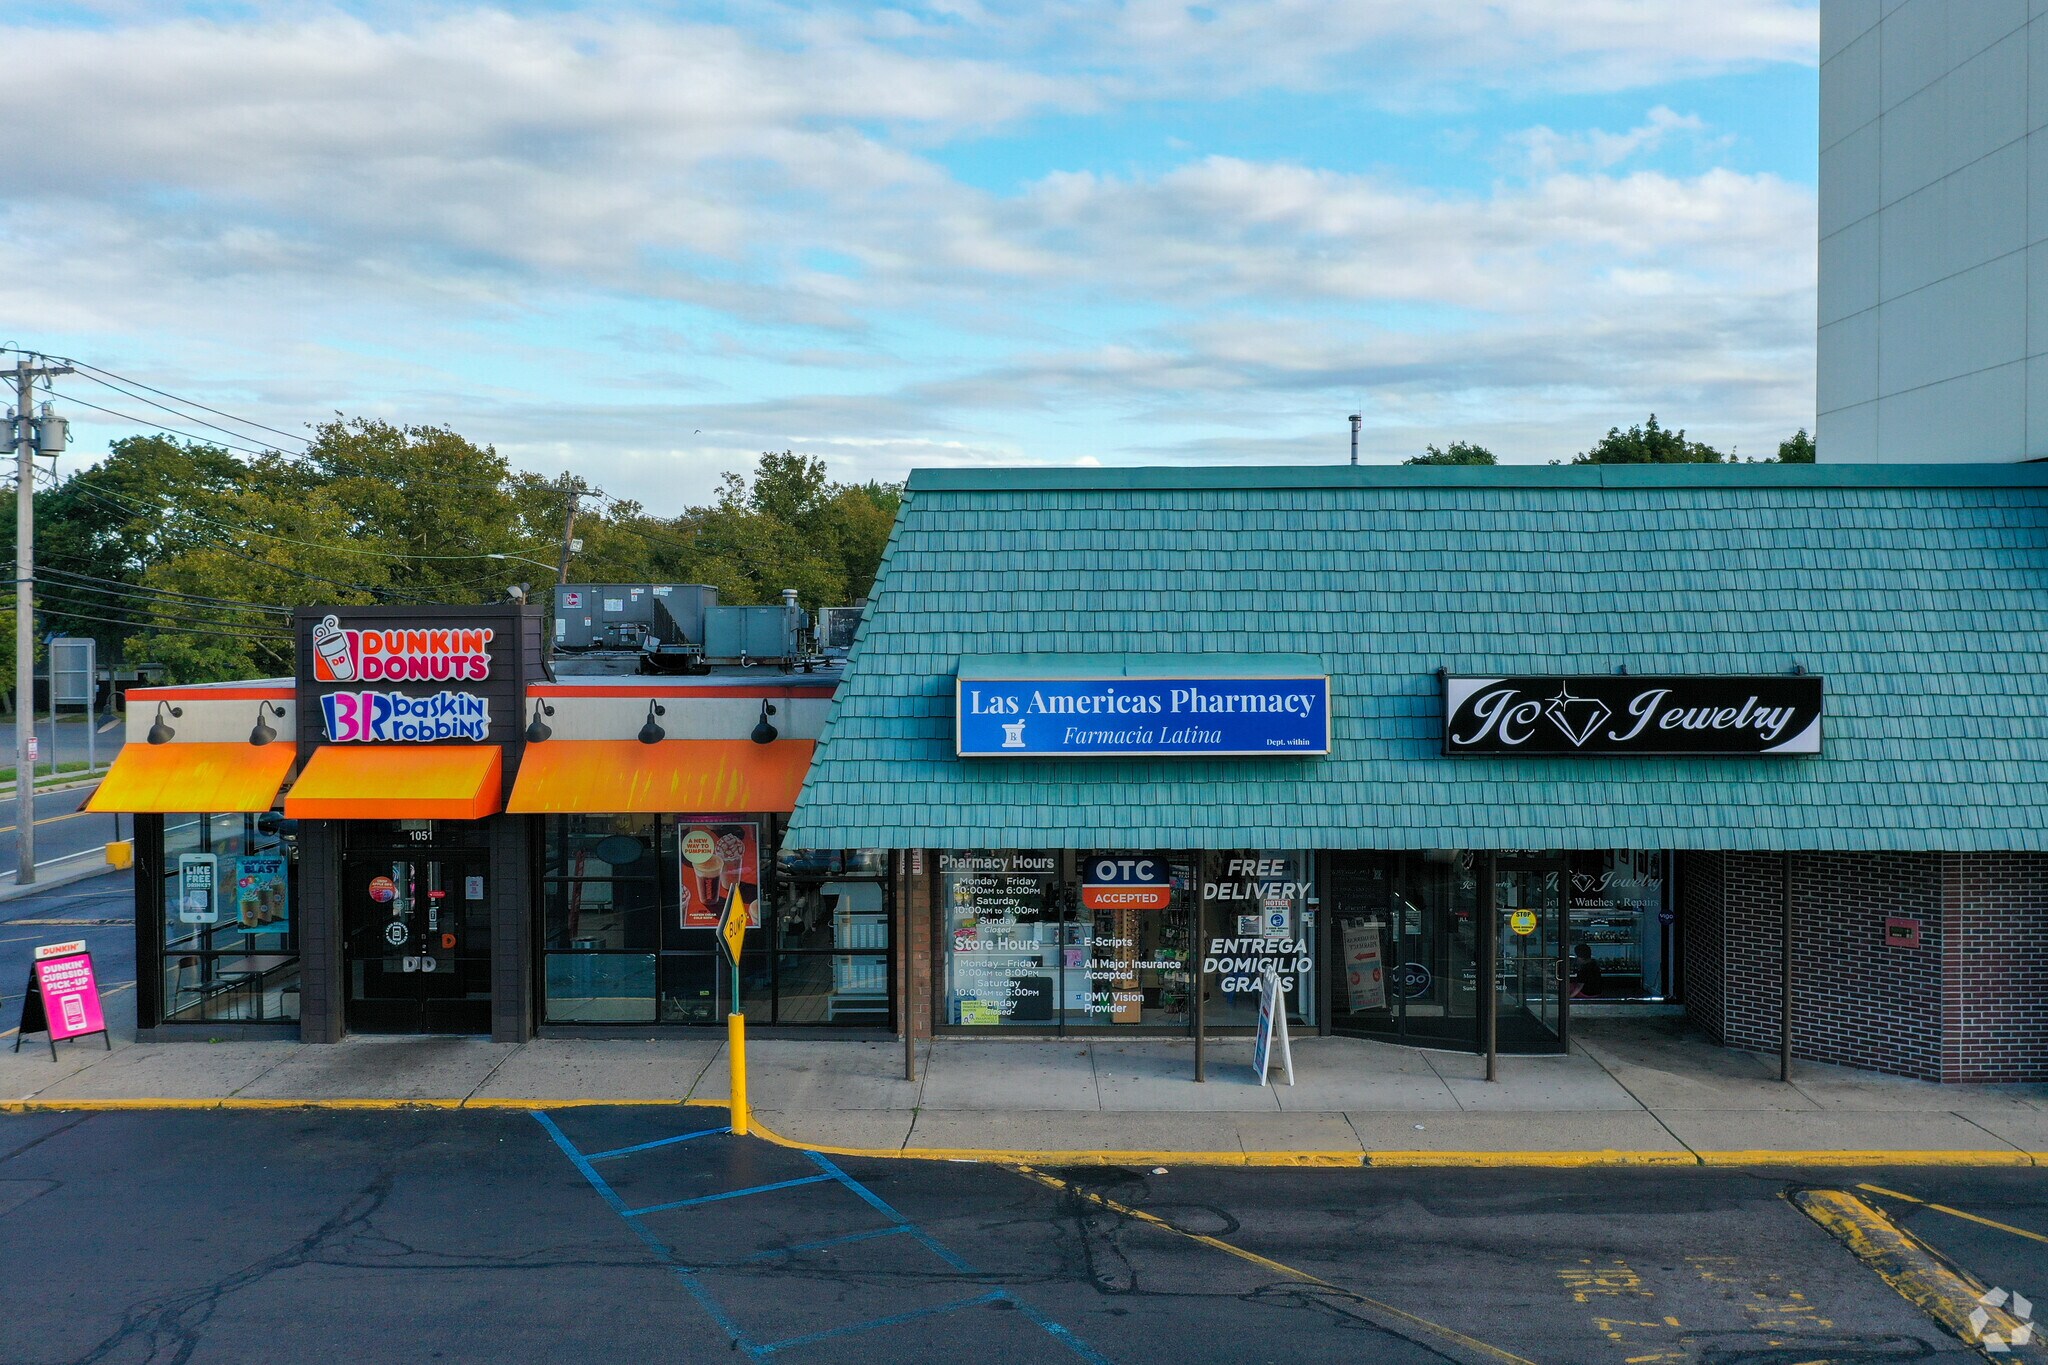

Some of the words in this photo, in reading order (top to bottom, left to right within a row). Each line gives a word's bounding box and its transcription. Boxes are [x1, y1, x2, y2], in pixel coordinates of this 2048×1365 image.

[363, 631, 492, 654] DUNKIN'
[363, 656, 487, 680] DONUTS
[392, 692, 483, 718] baskin
[970, 690, 1019, 715] Las
[1026, 688, 1162, 714] Americas
[1170, 687, 1316, 718] Pharmacy
[1452, 689, 1542, 745] JC
[1608, 688, 1796, 742] Jewelry
[393, 717, 484, 740] robbins
[1064, 725, 1153, 744] Farmacia
[1158, 725, 1222, 744] Latina
[1266, 738, 1285, 746] Dept.
[1286, 738, 1310, 746] within
[410, 831, 433, 840] 1051
[940, 855, 1008, 872] Pharmacy
[1012, 855, 1054, 868] Hours
[1228, 859, 1284, 876] FREE
[186, 866, 210, 875] LIKE
[244, 866, 279, 874] BLAST
[1096, 860, 1154, 881] OTC
[960, 877, 998, 886] Monday
[1006, 876, 1037, 886] Friday
[1592, 871, 1664, 892] Jewelry
[1006, 886, 1040, 894] 6:00PM
[1204, 882, 1312, 900] DELIVERY
[976, 897, 1020, 906] Saturday
[1094, 894, 1158, 904] ACCEPTED
[1575, 898, 1614, 906] Watches
[1624, 898, 1659, 908] Repairs
[1004, 906, 1038, 914] 4:00PM
[980, 917, 1017, 926] Sunday
[955, 937, 994, 950] Store
[998, 937, 1040, 950] Hours
[1084, 936, 1132, 948] E-Scripts
[1210, 938, 1308, 954] ENTREGA
[43, 943, 79, 955] DUNKIN'
[43, 960, 84, 974] DUNKIN'
[960, 960, 998, 968] Monday
[1007, 960, 1038, 968] Friday
[1084, 960, 1098, 968] All
[1100, 960, 1129, 970] Major
[1131, 960, 1181, 968] Insurance
[1204, 958, 1312, 973] DOMICILIO
[42, 968, 90, 982] CURBSIDE
[958, 968, 992, 977] 9:00AM
[1004, 968, 1038, 977] 8:00PM
[1084, 970, 1133, 981] Accepted
[47, 977, 88, 991] PICK-UP
[978, 980, 1020, 989] Saturday
[1221, 976, 1294, 992] GRAS
[956, 988, 994, 997] 10:00AM
[1006, 988, 1040, 997] 5:00PM
[1084, 992, 1110, 1002] DMV
[1112, 992, 1144, 1002] Vision
[980, 999, 1018, 1008] Sunday
[1084, 1003, 1127, 1013] Provider
